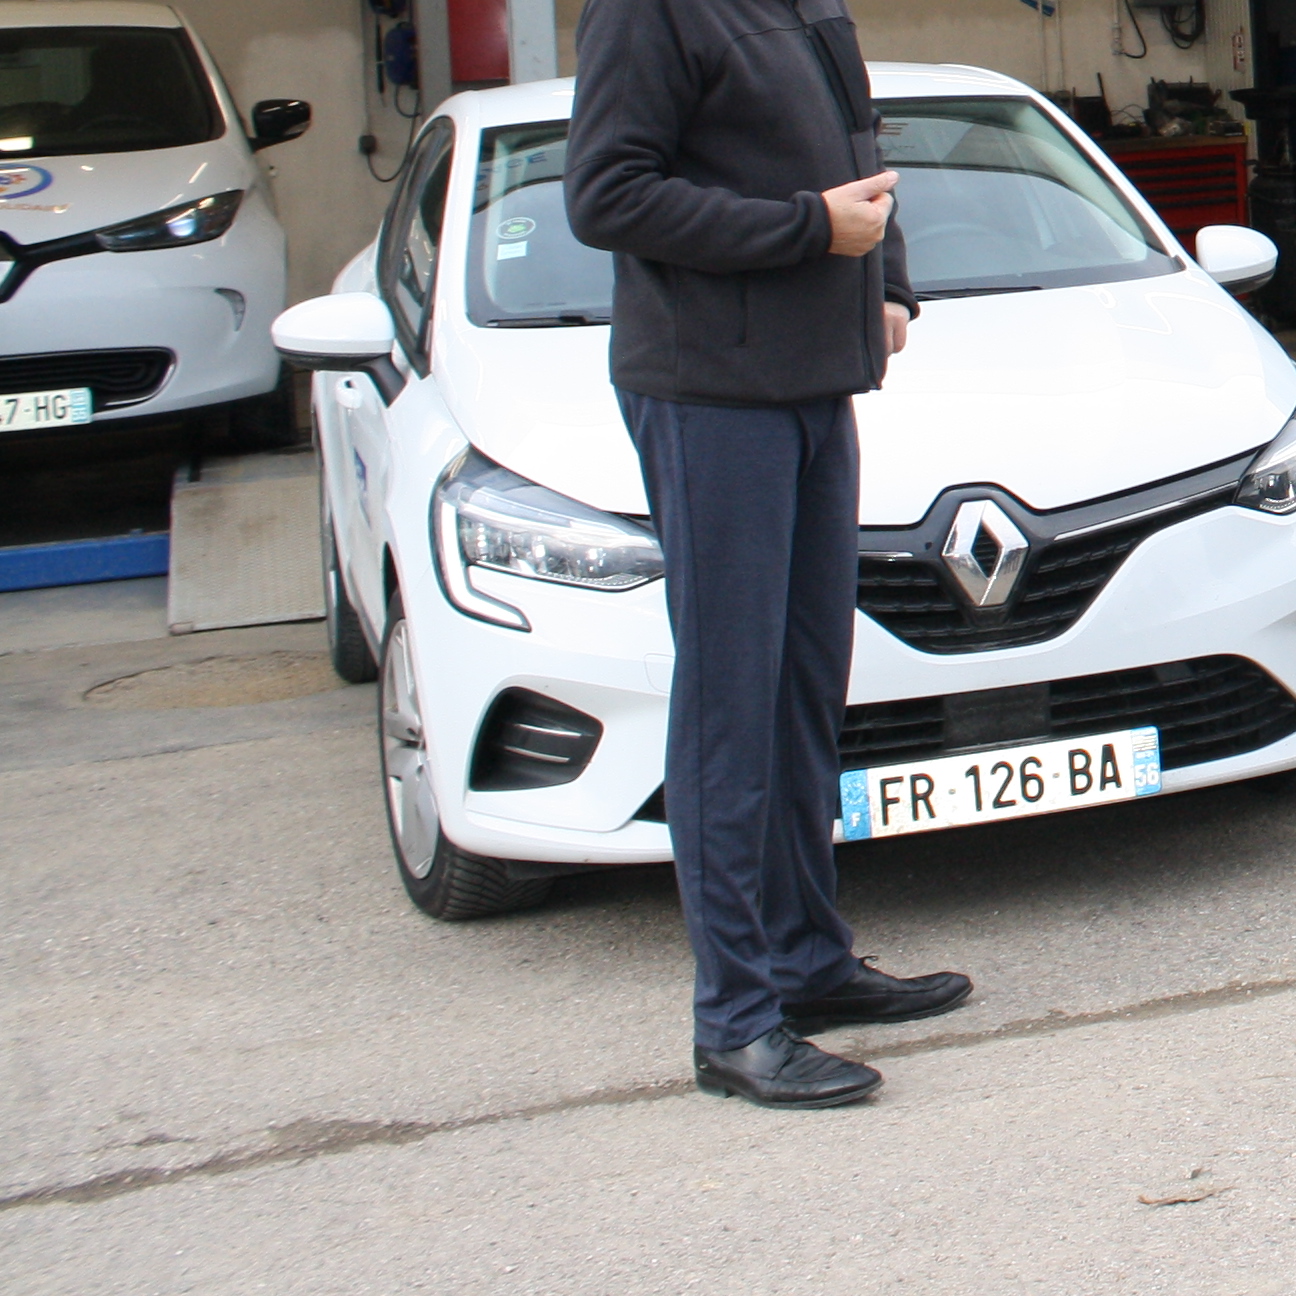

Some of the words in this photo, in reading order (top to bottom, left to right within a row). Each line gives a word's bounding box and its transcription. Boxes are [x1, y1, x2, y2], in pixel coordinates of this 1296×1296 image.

[0, 394, 70, 425] 7-HG
[1134, 762, 1159, 788] 56
[850, 814, 860, 828] F
